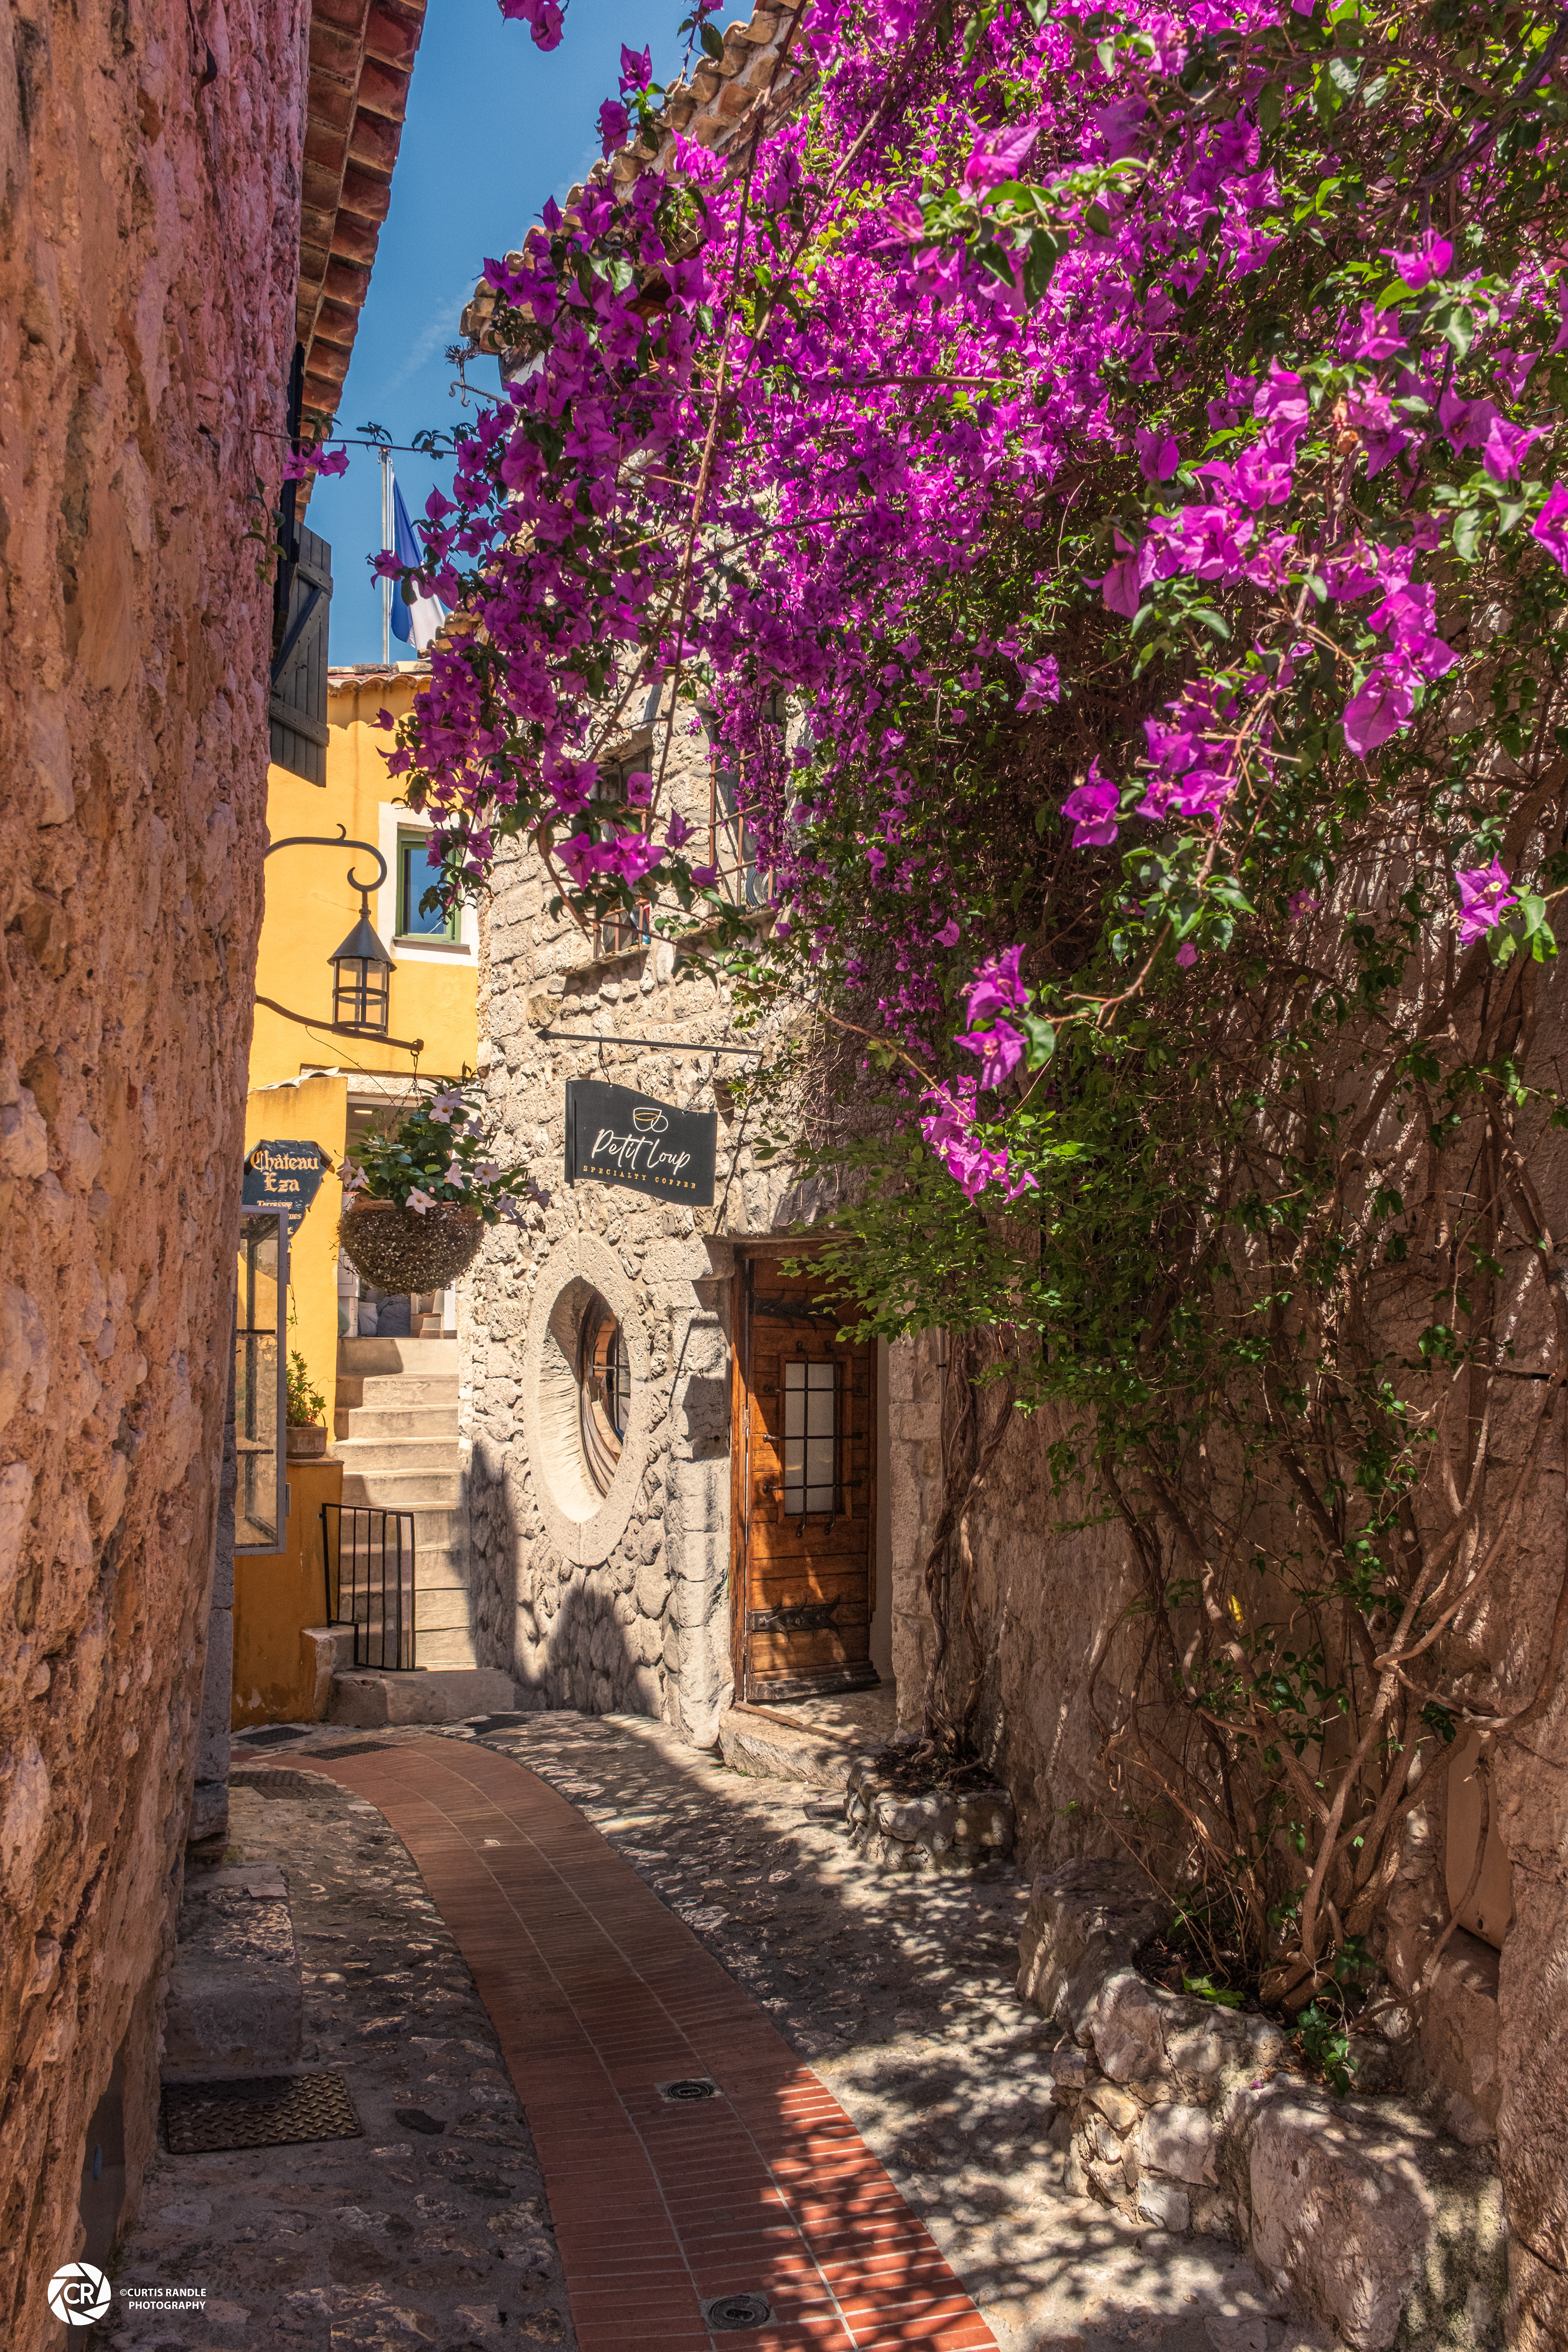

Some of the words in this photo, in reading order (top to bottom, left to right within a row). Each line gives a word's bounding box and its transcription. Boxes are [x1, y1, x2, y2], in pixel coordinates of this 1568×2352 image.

[250, 1149, 320, 1172] Château
[591, 1129, 654, 1170] Petit
[263, 1172, 301, 1193] Eza
[583, 1165, 647, 1181] SPECIALTY
[655, 1176, 696, 1189] COFFEE
